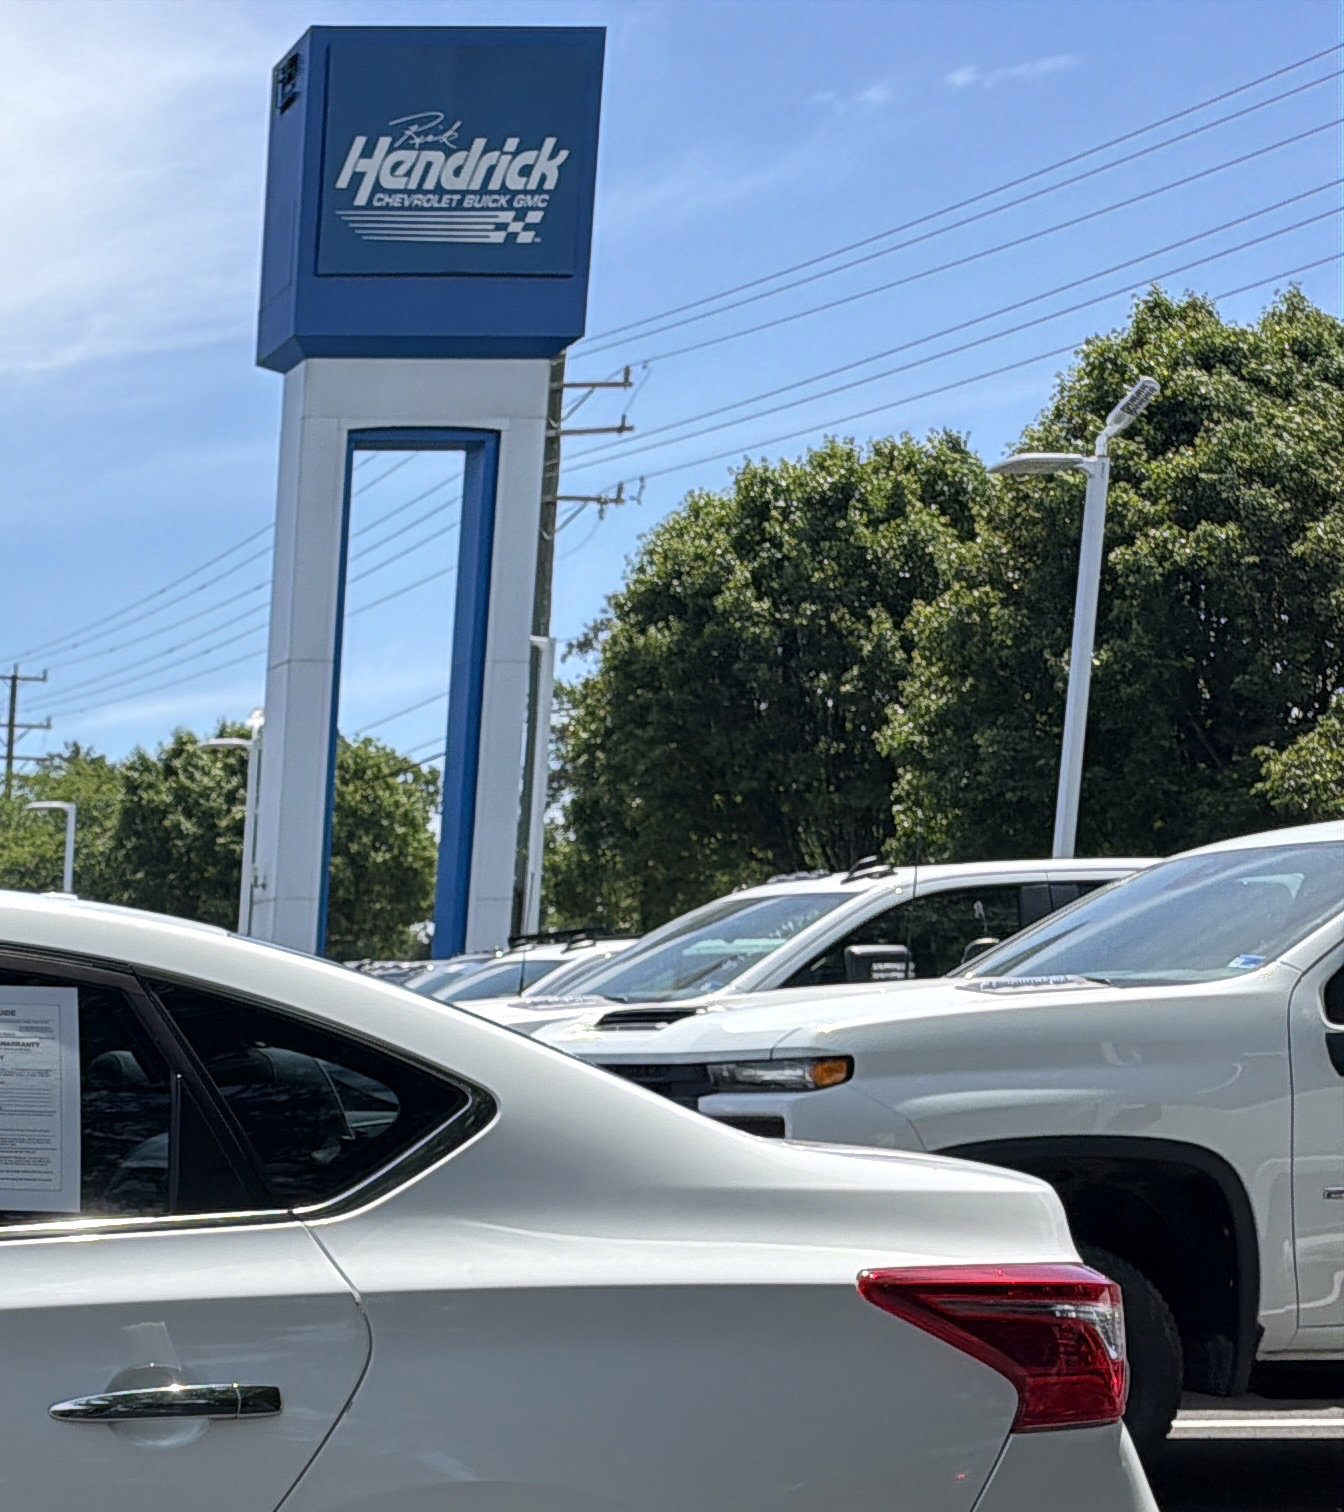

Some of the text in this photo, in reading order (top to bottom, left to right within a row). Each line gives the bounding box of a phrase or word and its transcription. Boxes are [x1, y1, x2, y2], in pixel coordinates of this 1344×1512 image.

[335, 136, 570, 206] Hendrick
[372, 193, 550, 208] CHEVROLET BUICK GMC
